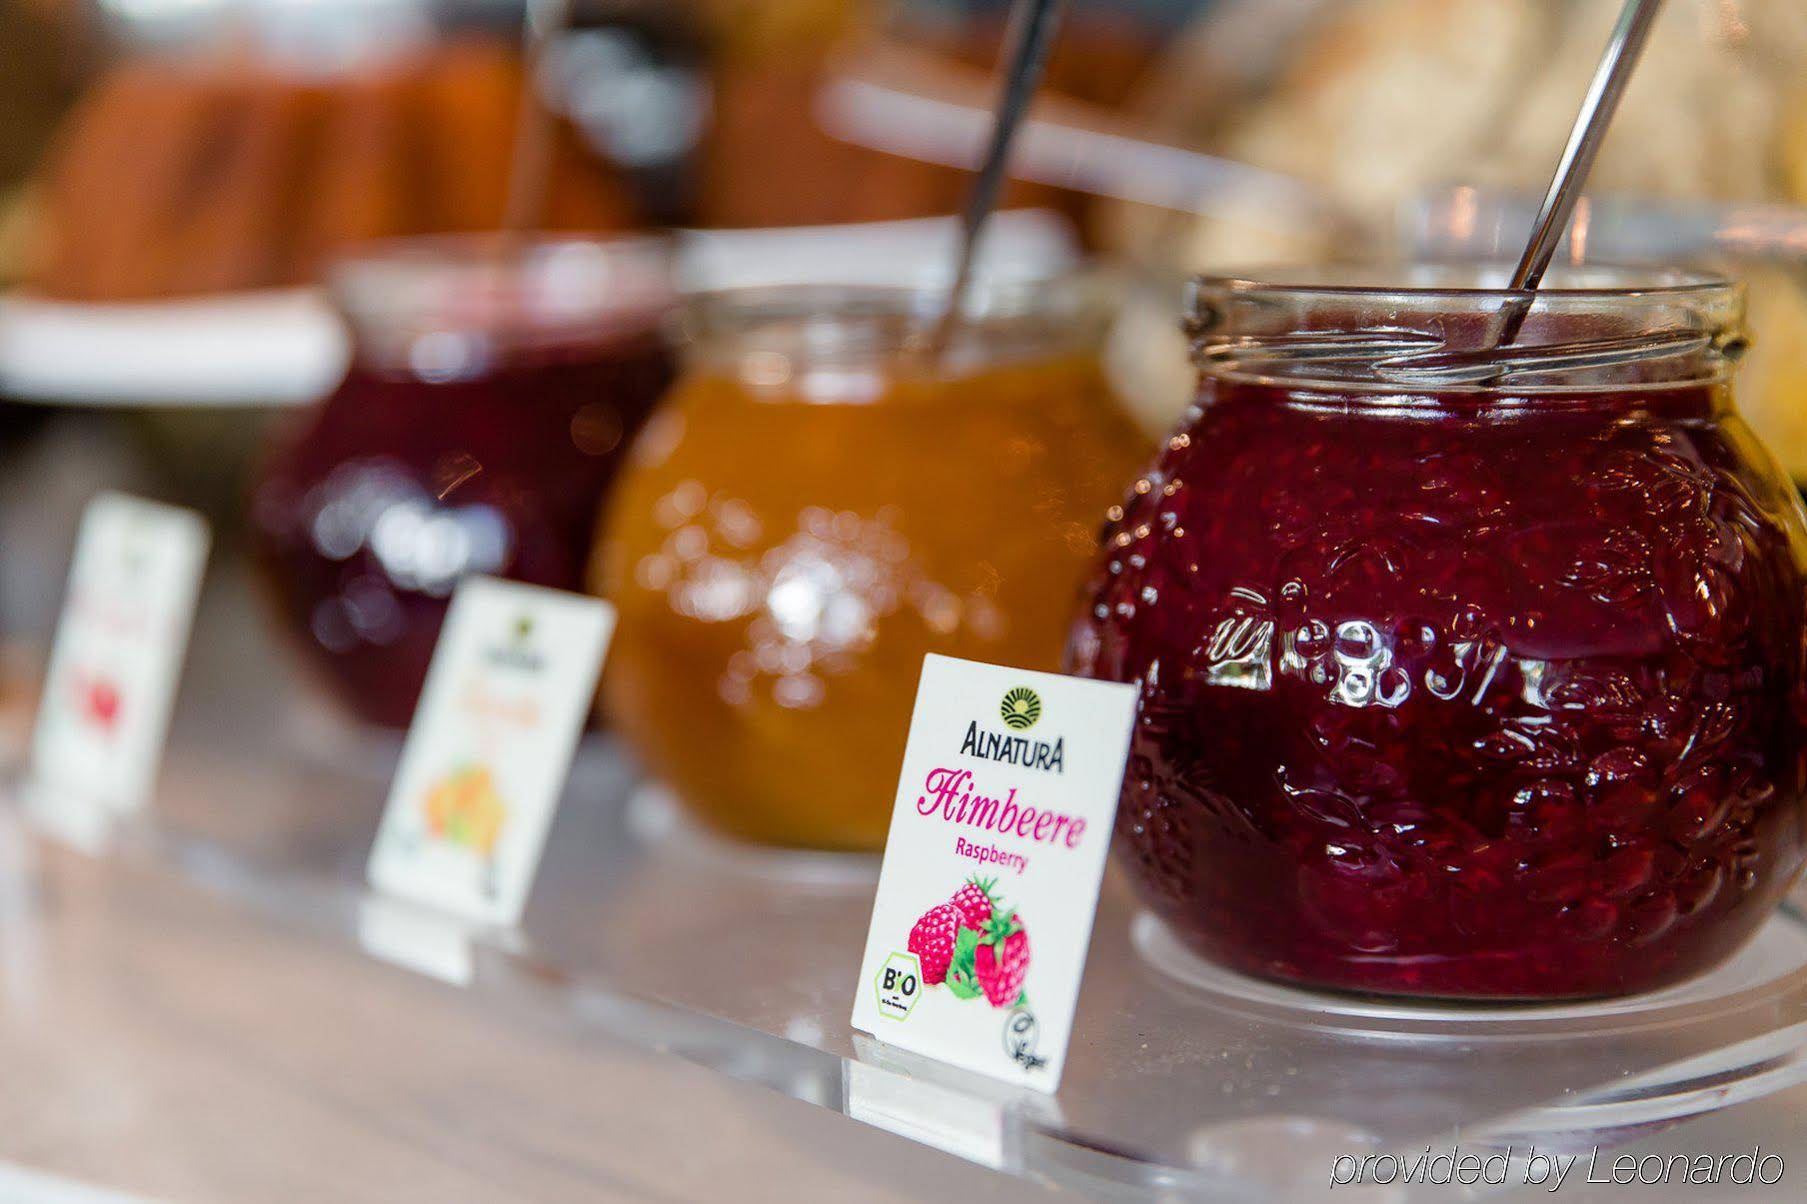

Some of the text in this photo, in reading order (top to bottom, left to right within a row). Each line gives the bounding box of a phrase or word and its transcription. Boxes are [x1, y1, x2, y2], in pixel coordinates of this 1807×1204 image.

[960, 720, 1064, 772] ALNATURA
[916, 767, 1087, 848] Himbeere
[955, 837, 1028, 874] Raspberry
